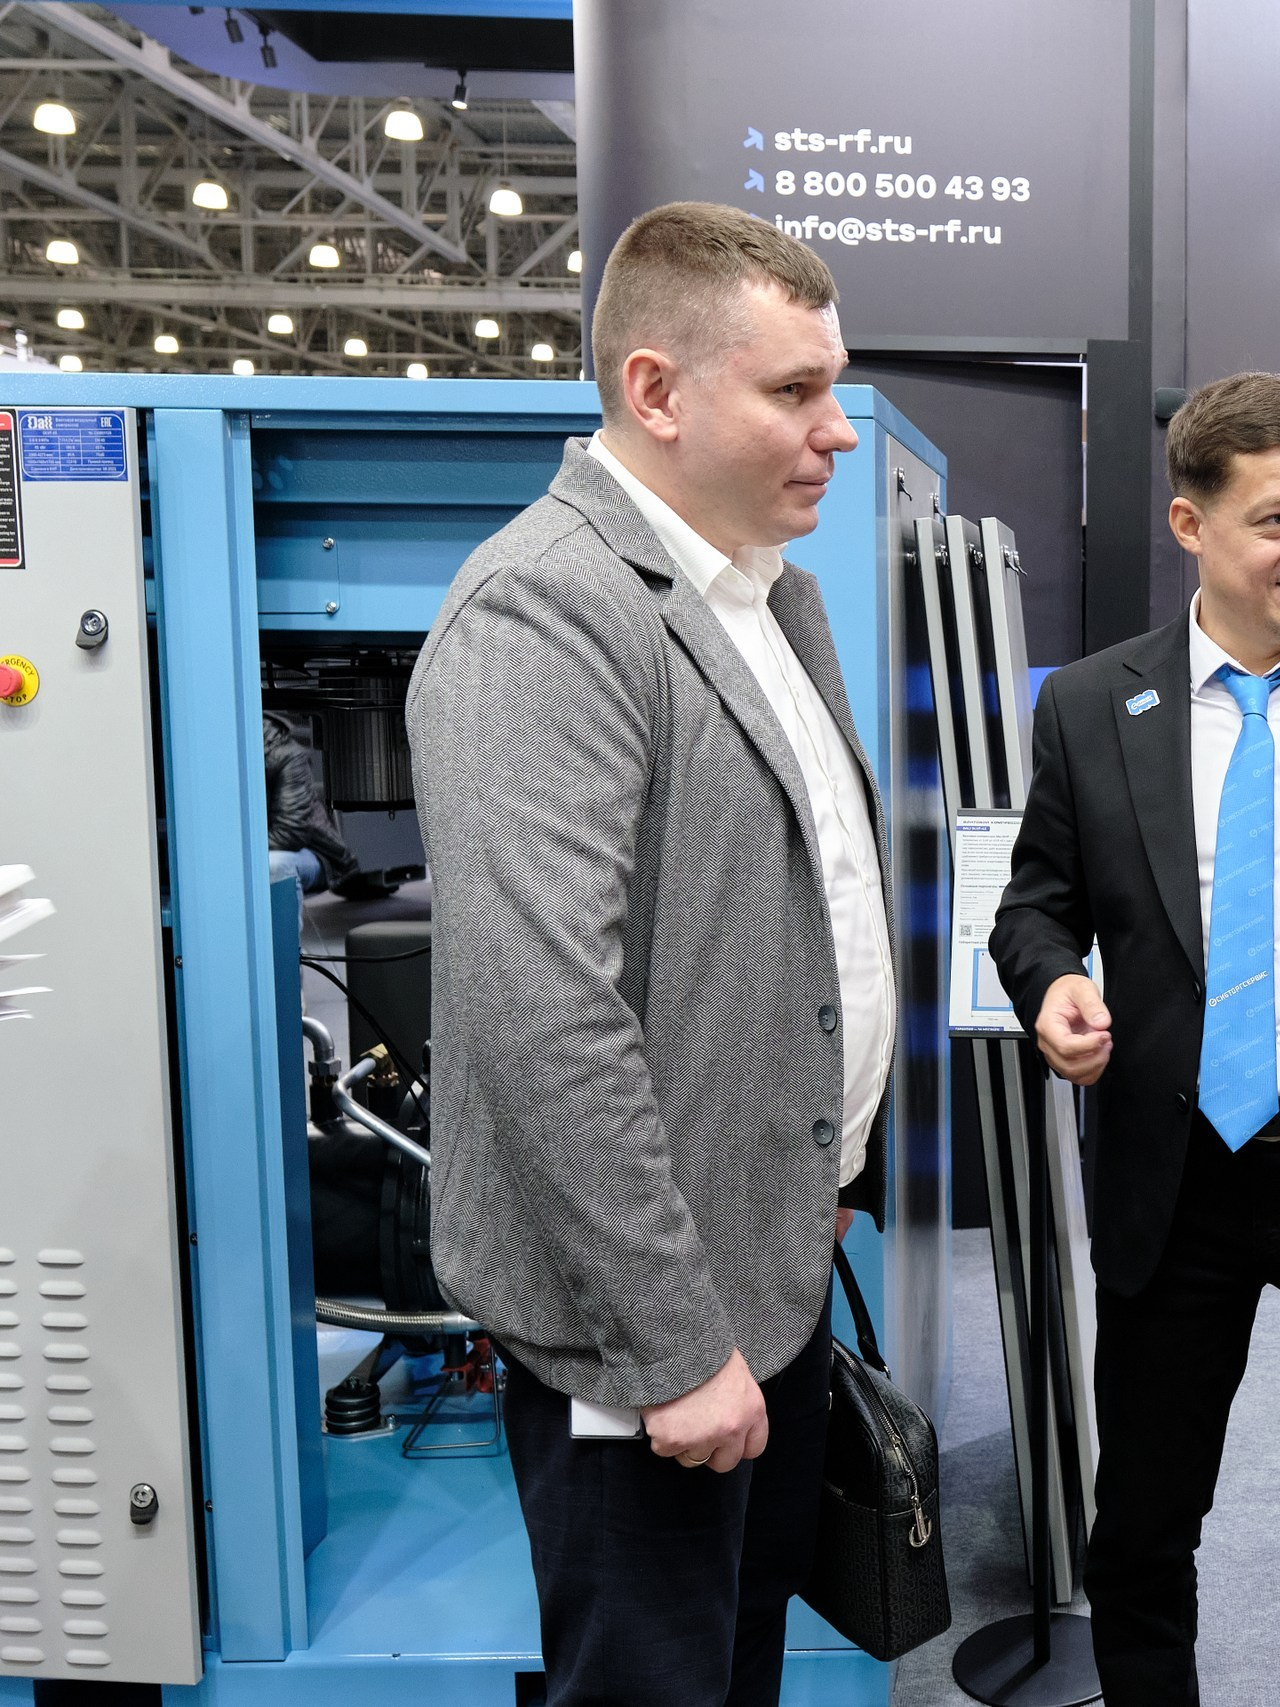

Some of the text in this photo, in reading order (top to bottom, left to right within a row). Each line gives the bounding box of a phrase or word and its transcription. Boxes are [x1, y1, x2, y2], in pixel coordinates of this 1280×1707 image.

[774, 128, 912, 154] sts-rf.ru
[775, 170, 1030, 202] 8 800 500 43 93
[775, 214, 1002, 245] info@sts-rf.ru
